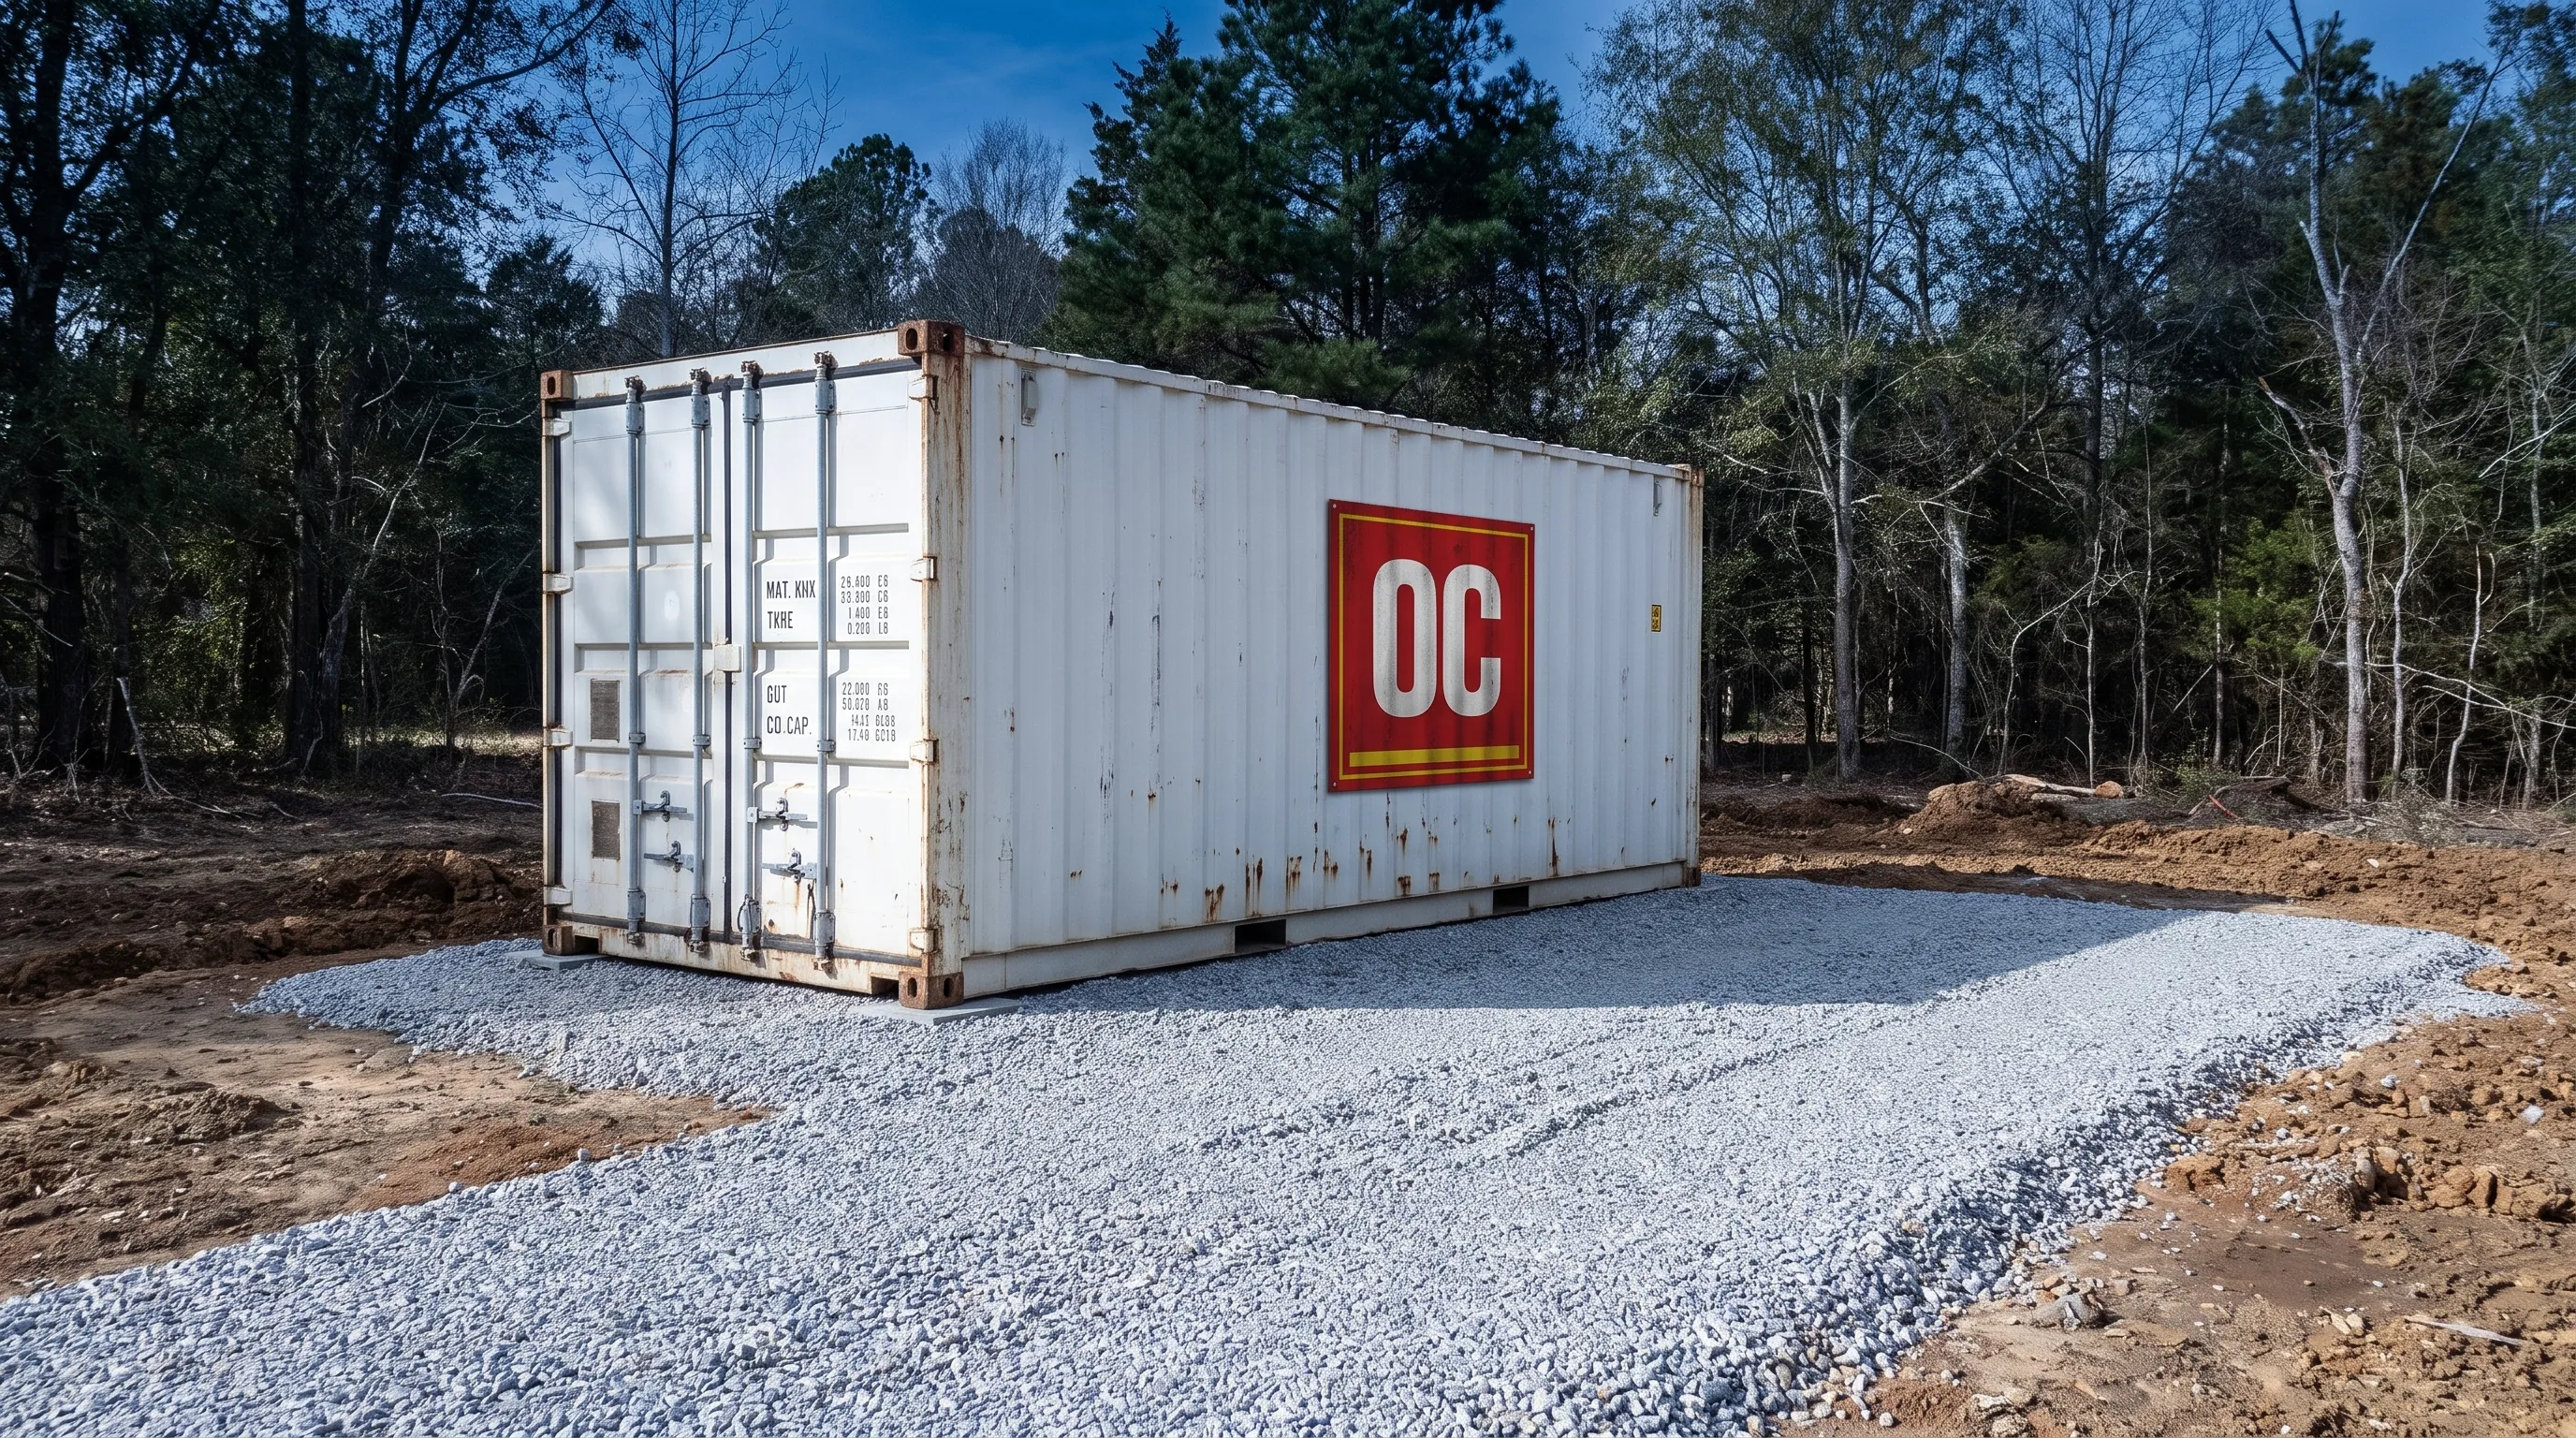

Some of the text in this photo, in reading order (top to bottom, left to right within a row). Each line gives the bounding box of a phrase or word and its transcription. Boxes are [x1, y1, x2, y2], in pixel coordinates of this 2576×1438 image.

[767, 580, 816, 599] MAT. KNX
[1373, 559, 1501, 718] OC
[767, 684, 787, 704] GUT
[767, 715, 812, 735] CO.CAP.
